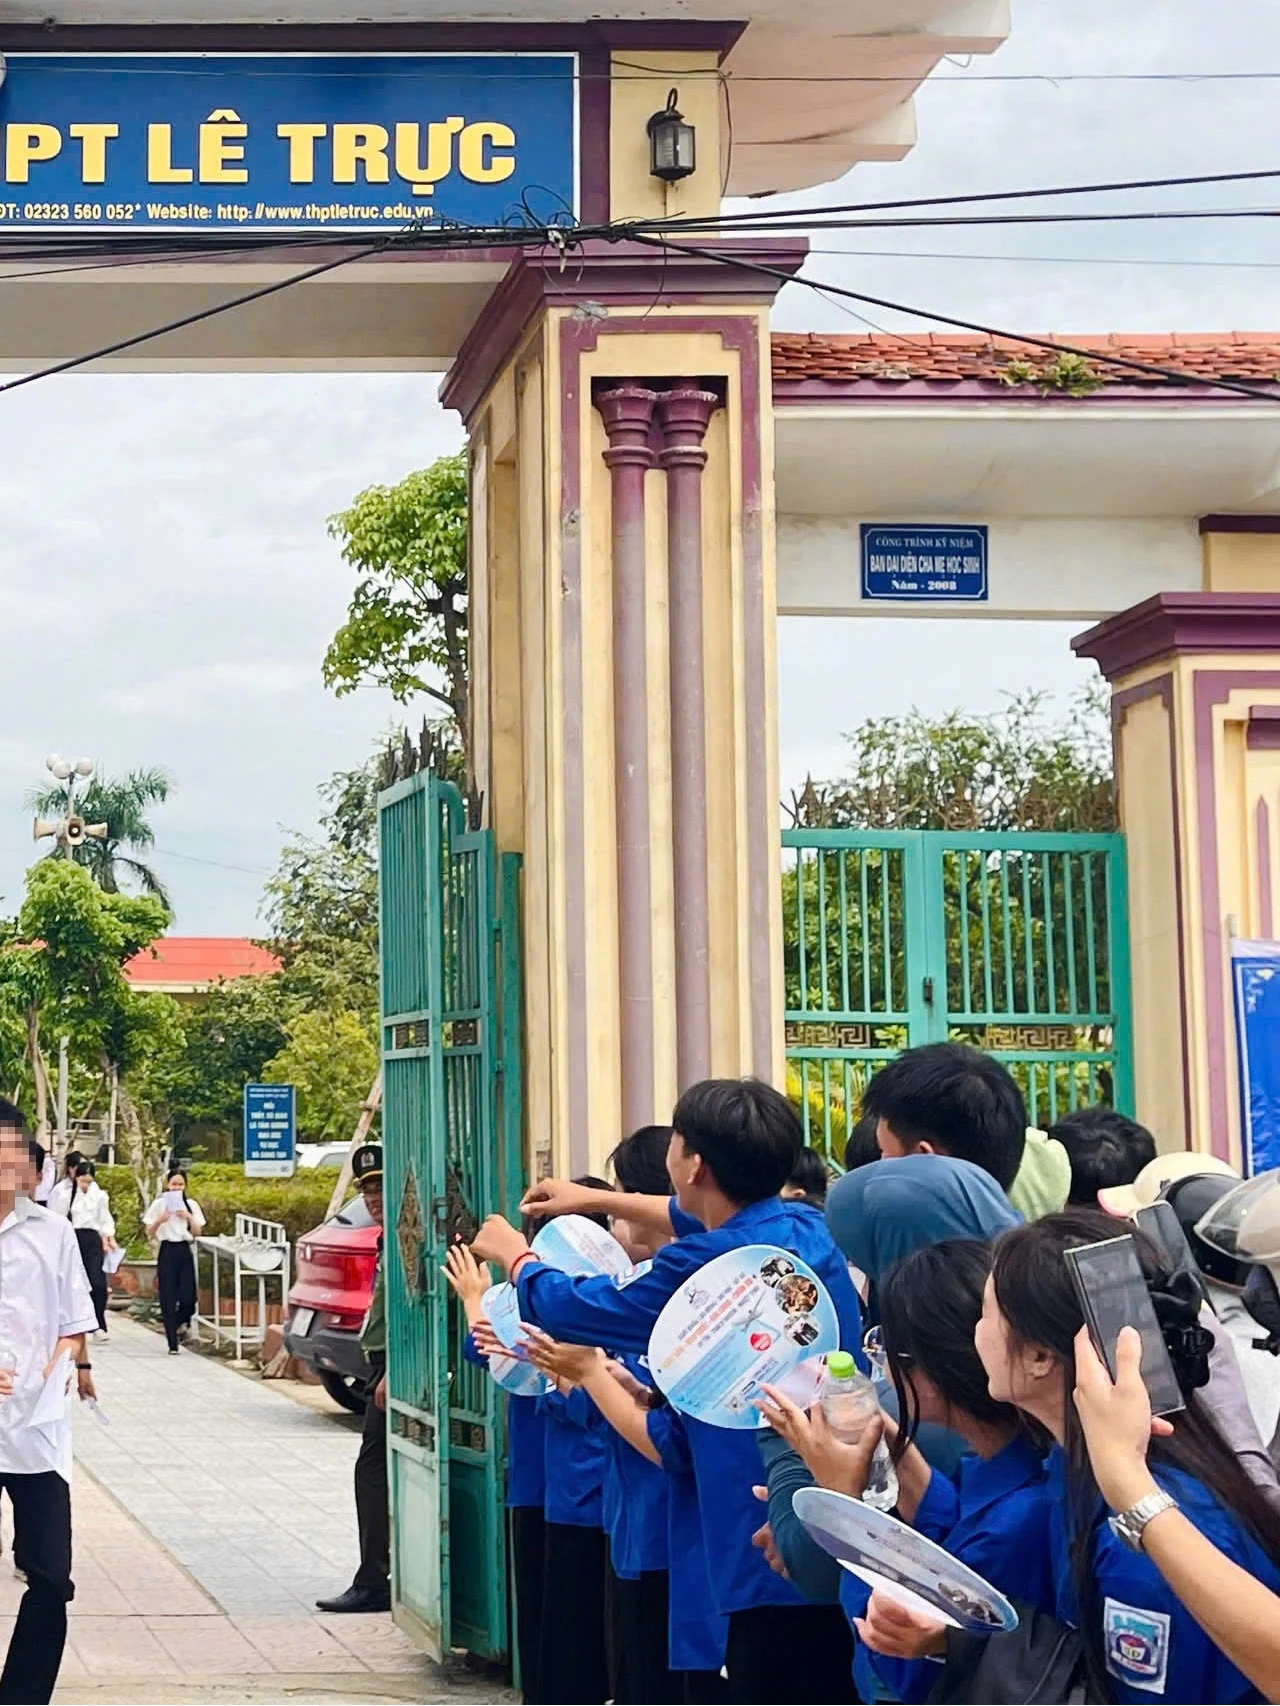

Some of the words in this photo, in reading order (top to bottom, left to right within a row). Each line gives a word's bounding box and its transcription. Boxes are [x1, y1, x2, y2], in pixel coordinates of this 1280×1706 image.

[147, 109, 249, 184] LÊ
[277, 116, 517, 196] TRỰC
[24, 203, 70, 220] 02323
[73, 203, 102, 220] 560
[146, 203, 212, 219] Website:
[870, 554, 886, 573] BAN
[918, 555, 934, 573] CHA
[946, 556, 962, 579] HỌC
[963, 556, 980, 574] SINH
[927, 580, 957, 590] 2008
